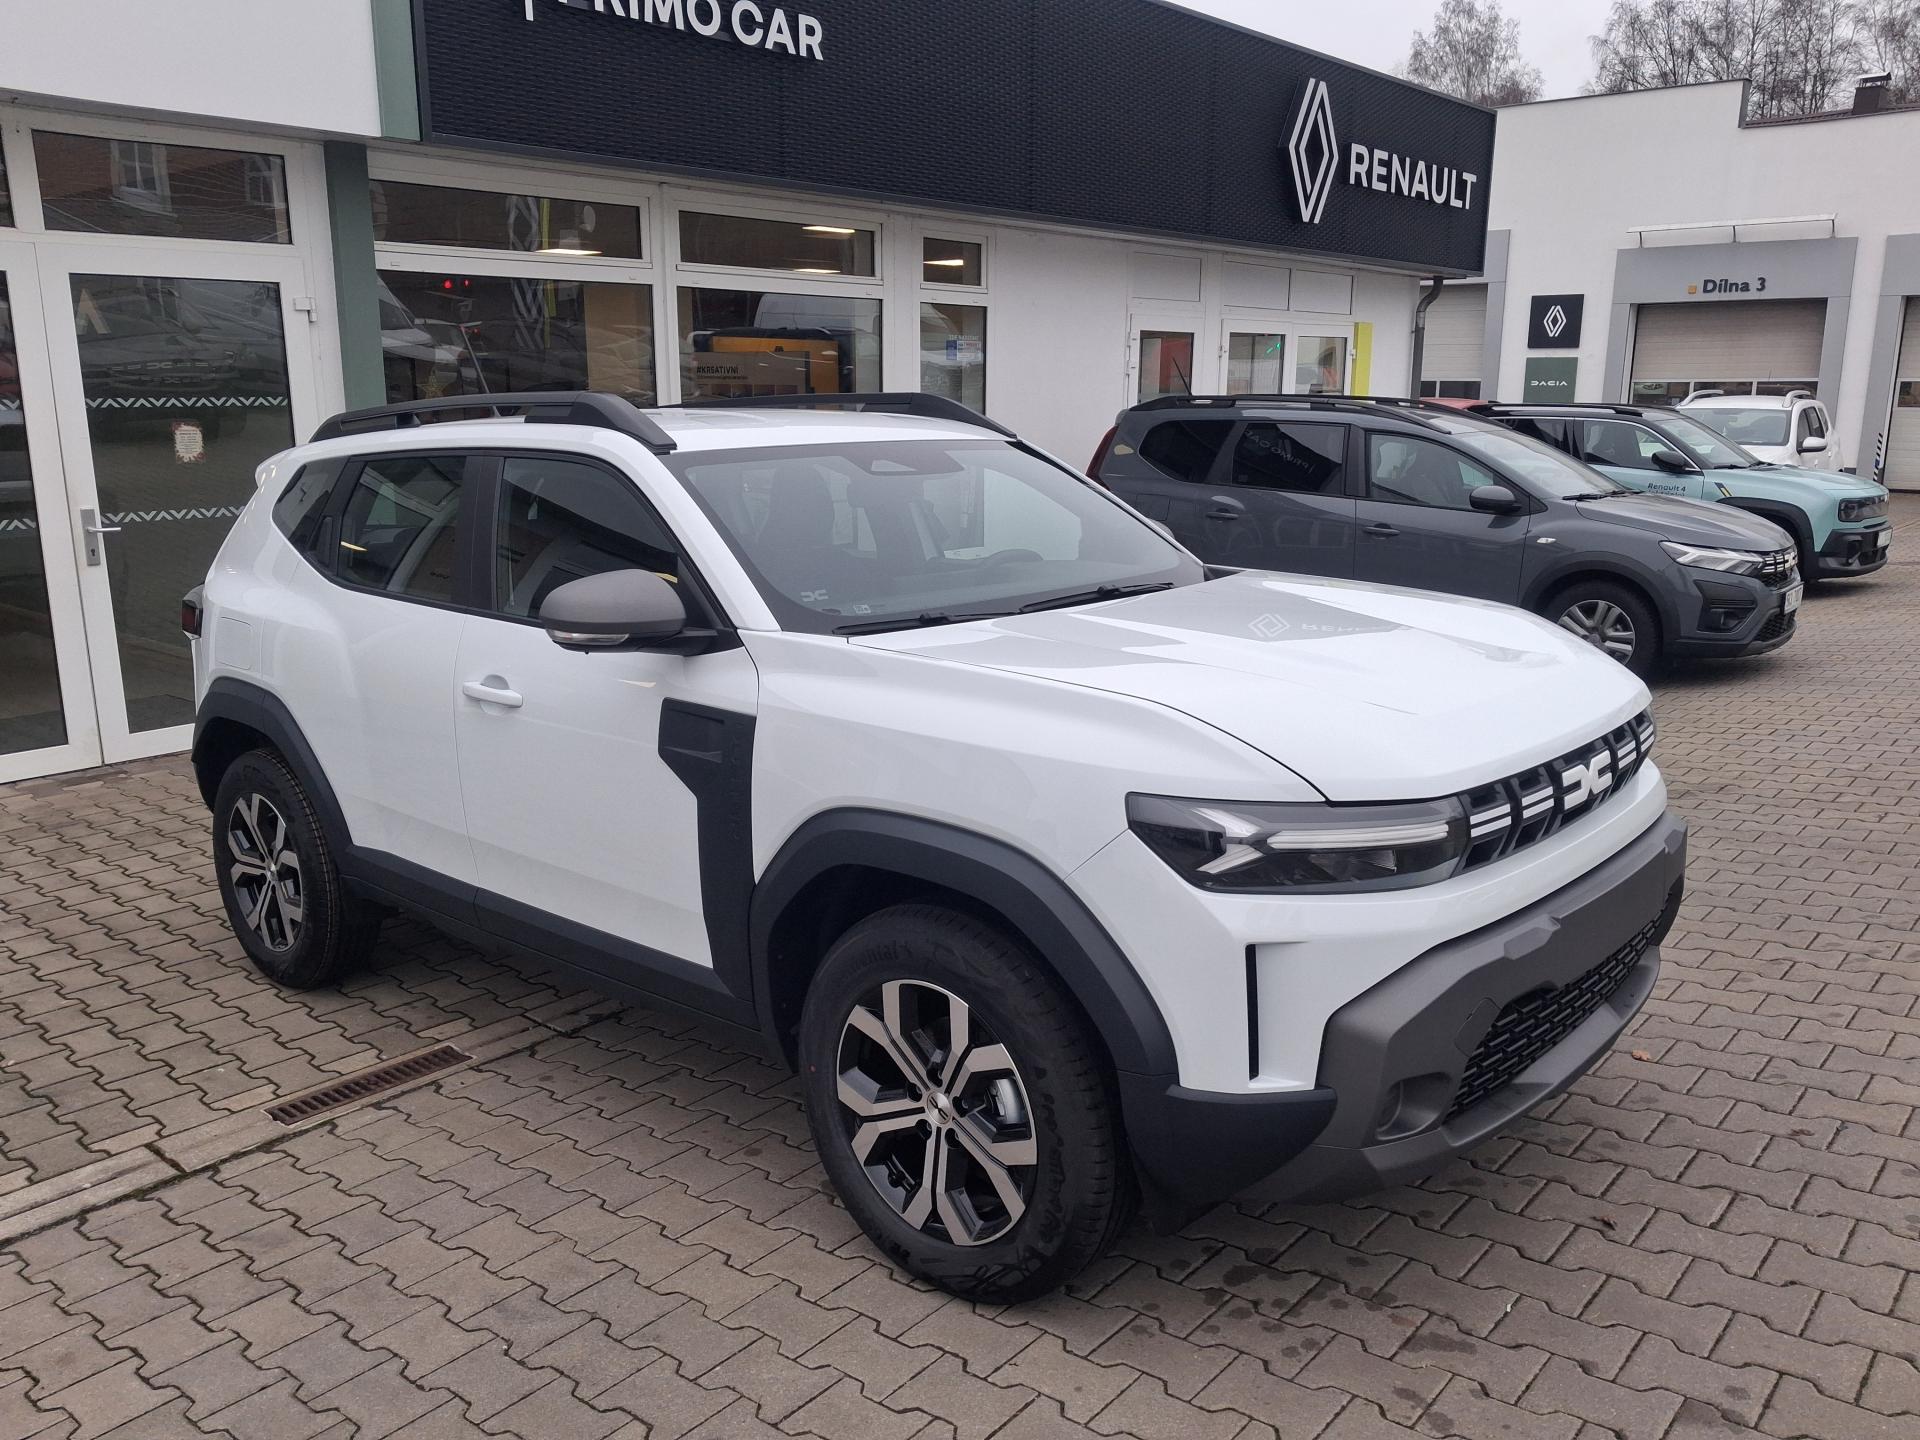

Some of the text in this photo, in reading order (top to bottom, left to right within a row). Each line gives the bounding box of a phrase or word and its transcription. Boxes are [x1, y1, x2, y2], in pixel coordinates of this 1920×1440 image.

[731, 0, 824, 60] CAR
[1349, 142, 1478, 210] RENAULT
[1702, 276, 1767, 294] Dílna 3
[1647, 482, 1680, 492] Renault
